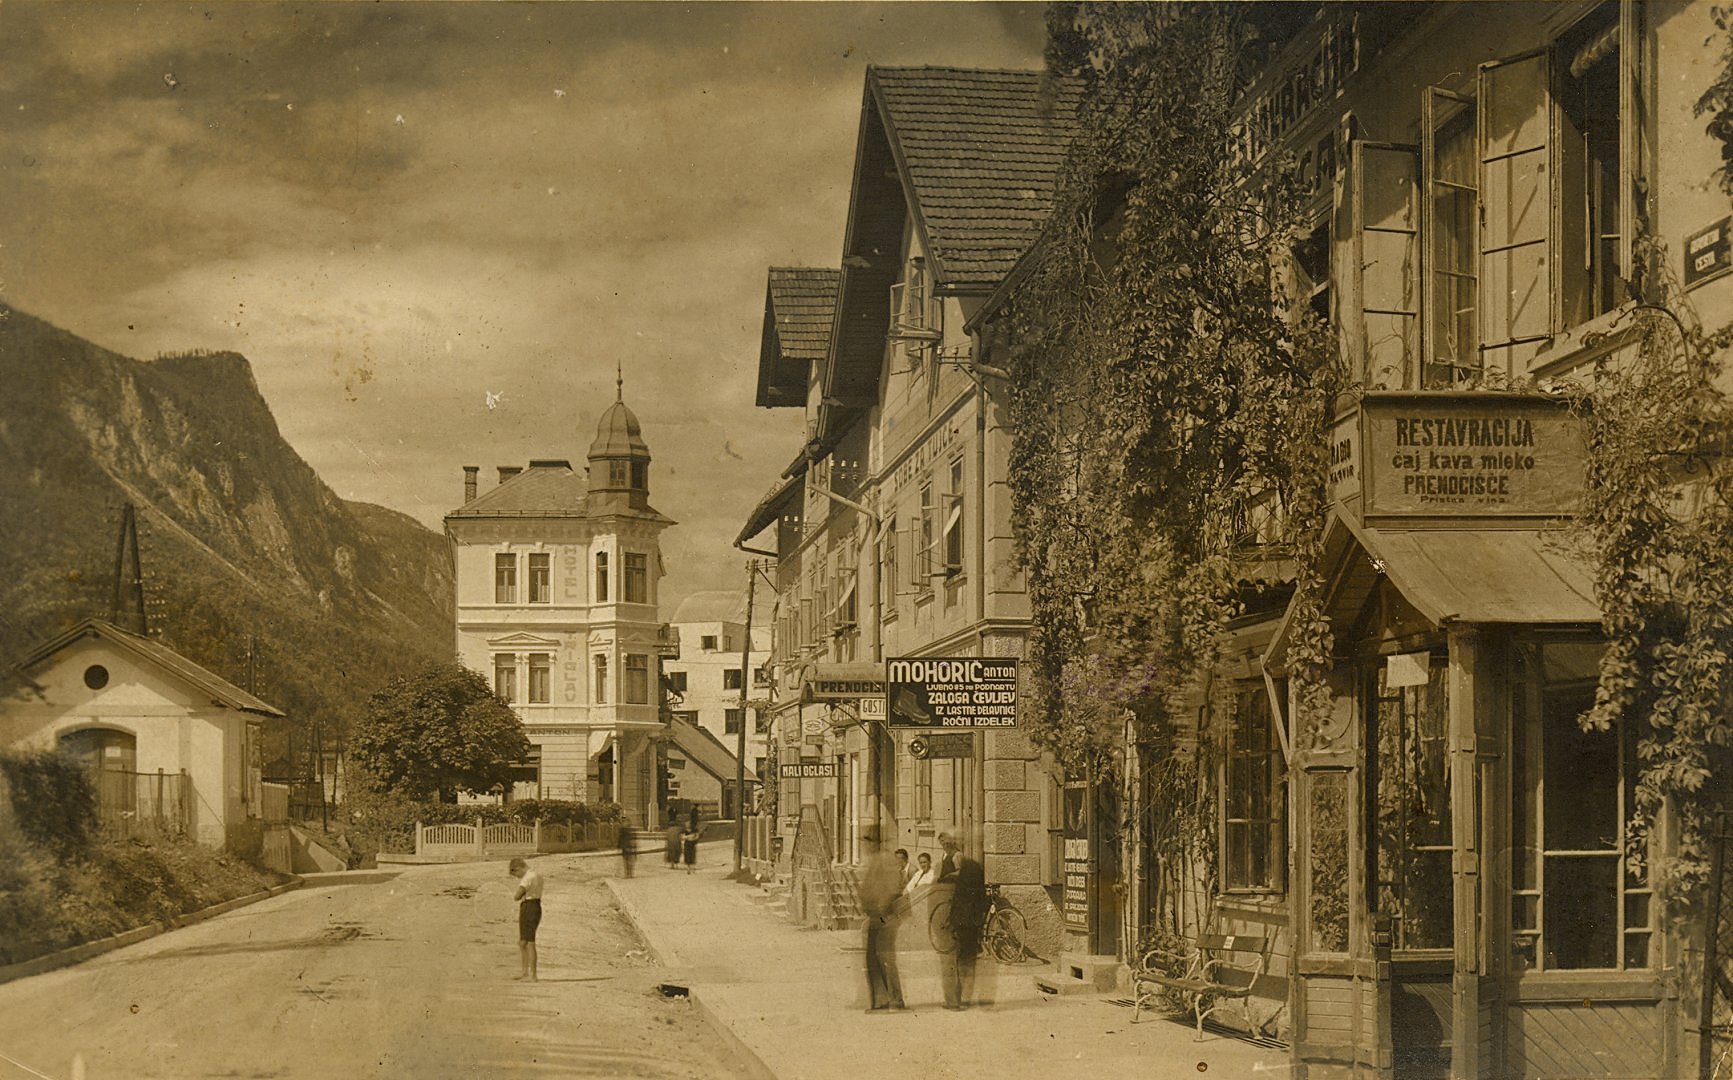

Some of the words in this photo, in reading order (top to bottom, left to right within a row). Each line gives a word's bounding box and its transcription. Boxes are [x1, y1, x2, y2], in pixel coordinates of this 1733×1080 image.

[1396, 418, 1534, 447] RESTAVRACIJA
[1392, 450, 1421, 472] čaj
[1429, 451, 1473, 470] kava
[1480, 452, 1535, 470] mleko
[889, 660, 983, 683] MOHORIČ
[984, 667, 1015, 678] ANTON
[928, 692, 970, 704] ZALOGA
[973, 690, 1015, 704] ČEVLJEV
[935, 706, 944, 715] IZ
[946, 706, 976, 715] LASTNE
[977, 706, 1015, 715] DELAVNICE
[942, 715, 971, 726] ROČNI
[973, 717, 1015, 726] IZDELEK
